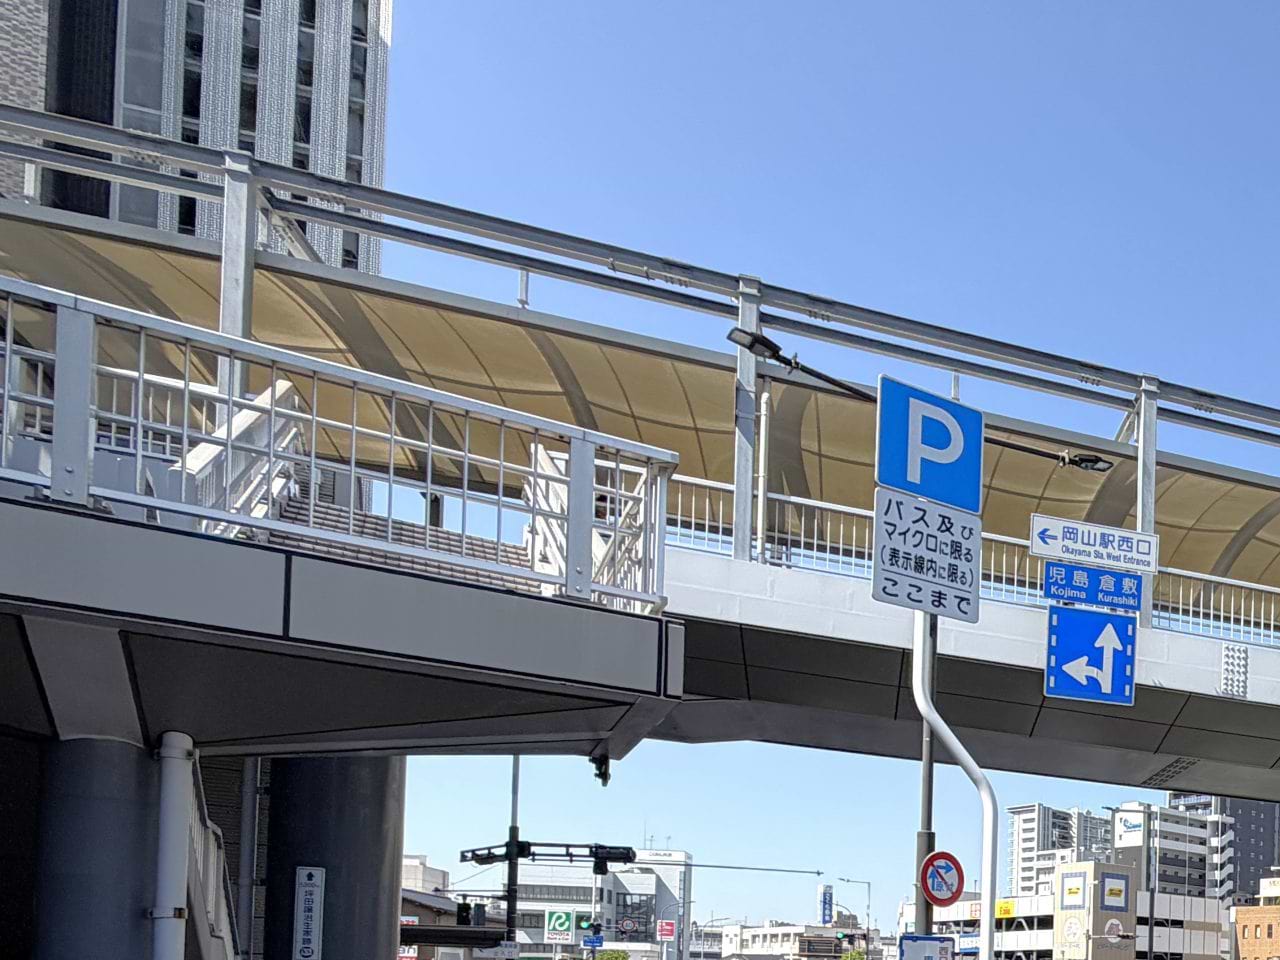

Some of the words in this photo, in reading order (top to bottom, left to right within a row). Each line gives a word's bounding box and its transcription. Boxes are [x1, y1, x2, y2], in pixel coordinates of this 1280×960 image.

[907, 397, 965, 485] P
[883, 498, 974, 541] バス及び
[883, 521, 974, 563] マイクロに限る
[1061, 544, 1091, 558] Okayama
[1093, 549, 1105, 560] Sta.
[1106, 552, 1121, 563] West
[1123, 554, 1151, 568] Entrance
[1062, 524, 1151, 556] 岡山駅西口
[880, 544, 974, 588] (表示線内に限る)
[1049, 566, 1089, 588] 児島
[1099, 574, 1138, 595] 倉敷
[882, 577, 971, 615] ここまで
[1050, 585, 1087, 599] Kojima
[1098, 591, 1138, 607] Kurashiki
